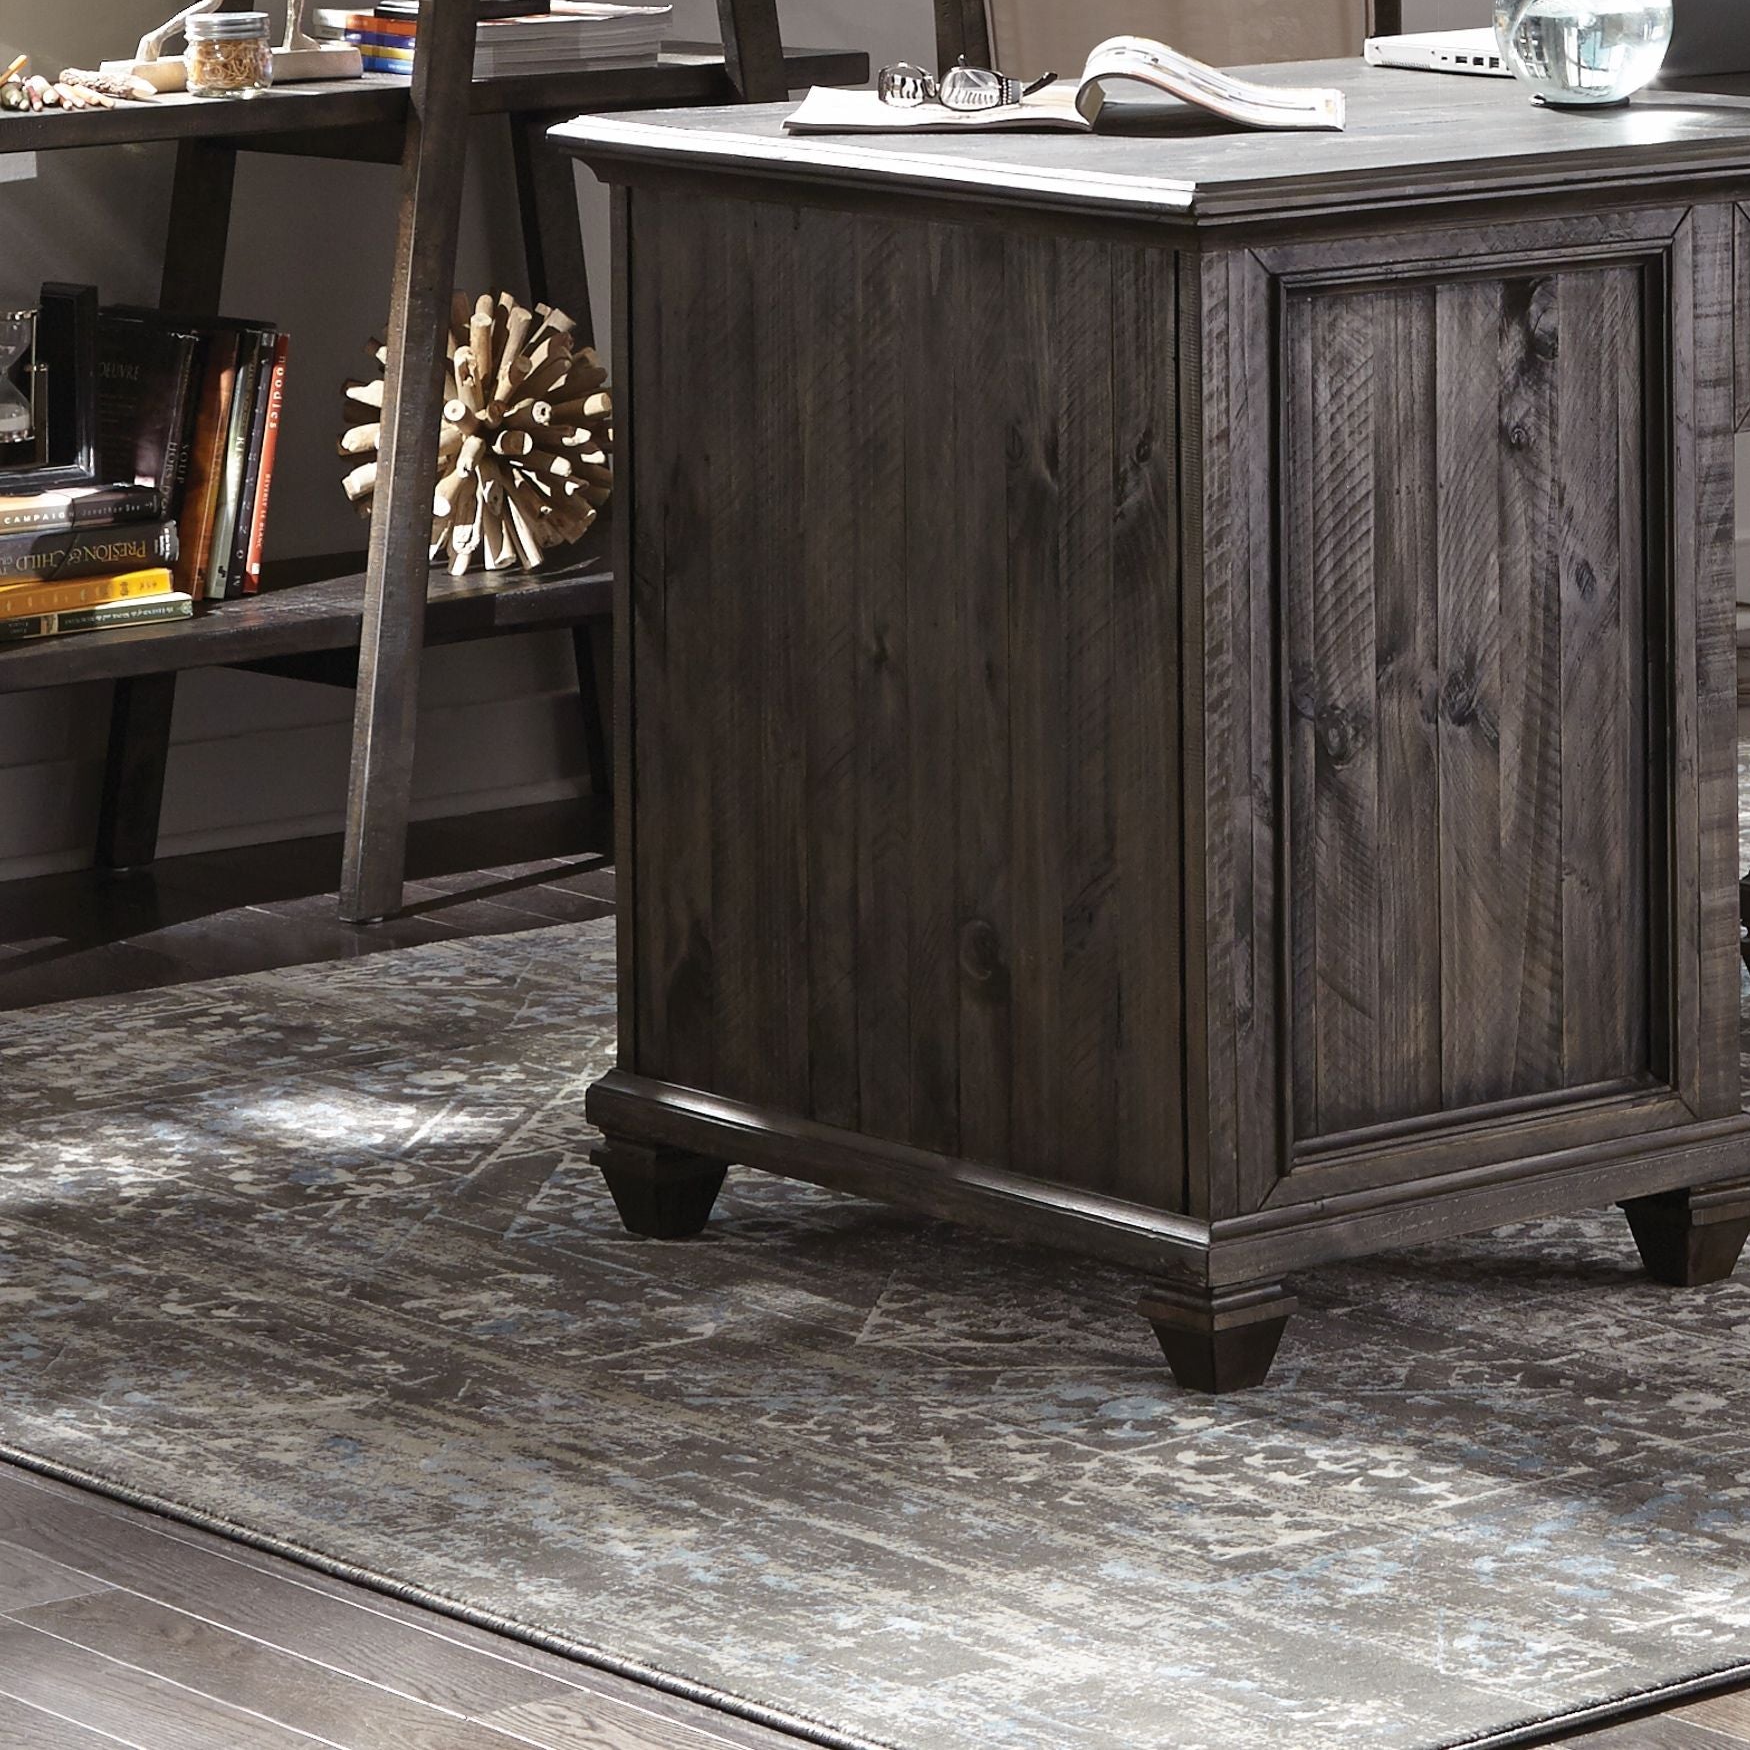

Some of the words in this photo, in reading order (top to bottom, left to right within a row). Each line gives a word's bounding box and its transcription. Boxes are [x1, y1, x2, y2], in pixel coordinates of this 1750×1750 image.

[4, 509, 75, 525] CAMPAIGN
[15, 551, 66, 571] CHILD
[85, 540, 147, 562] PRESTON
